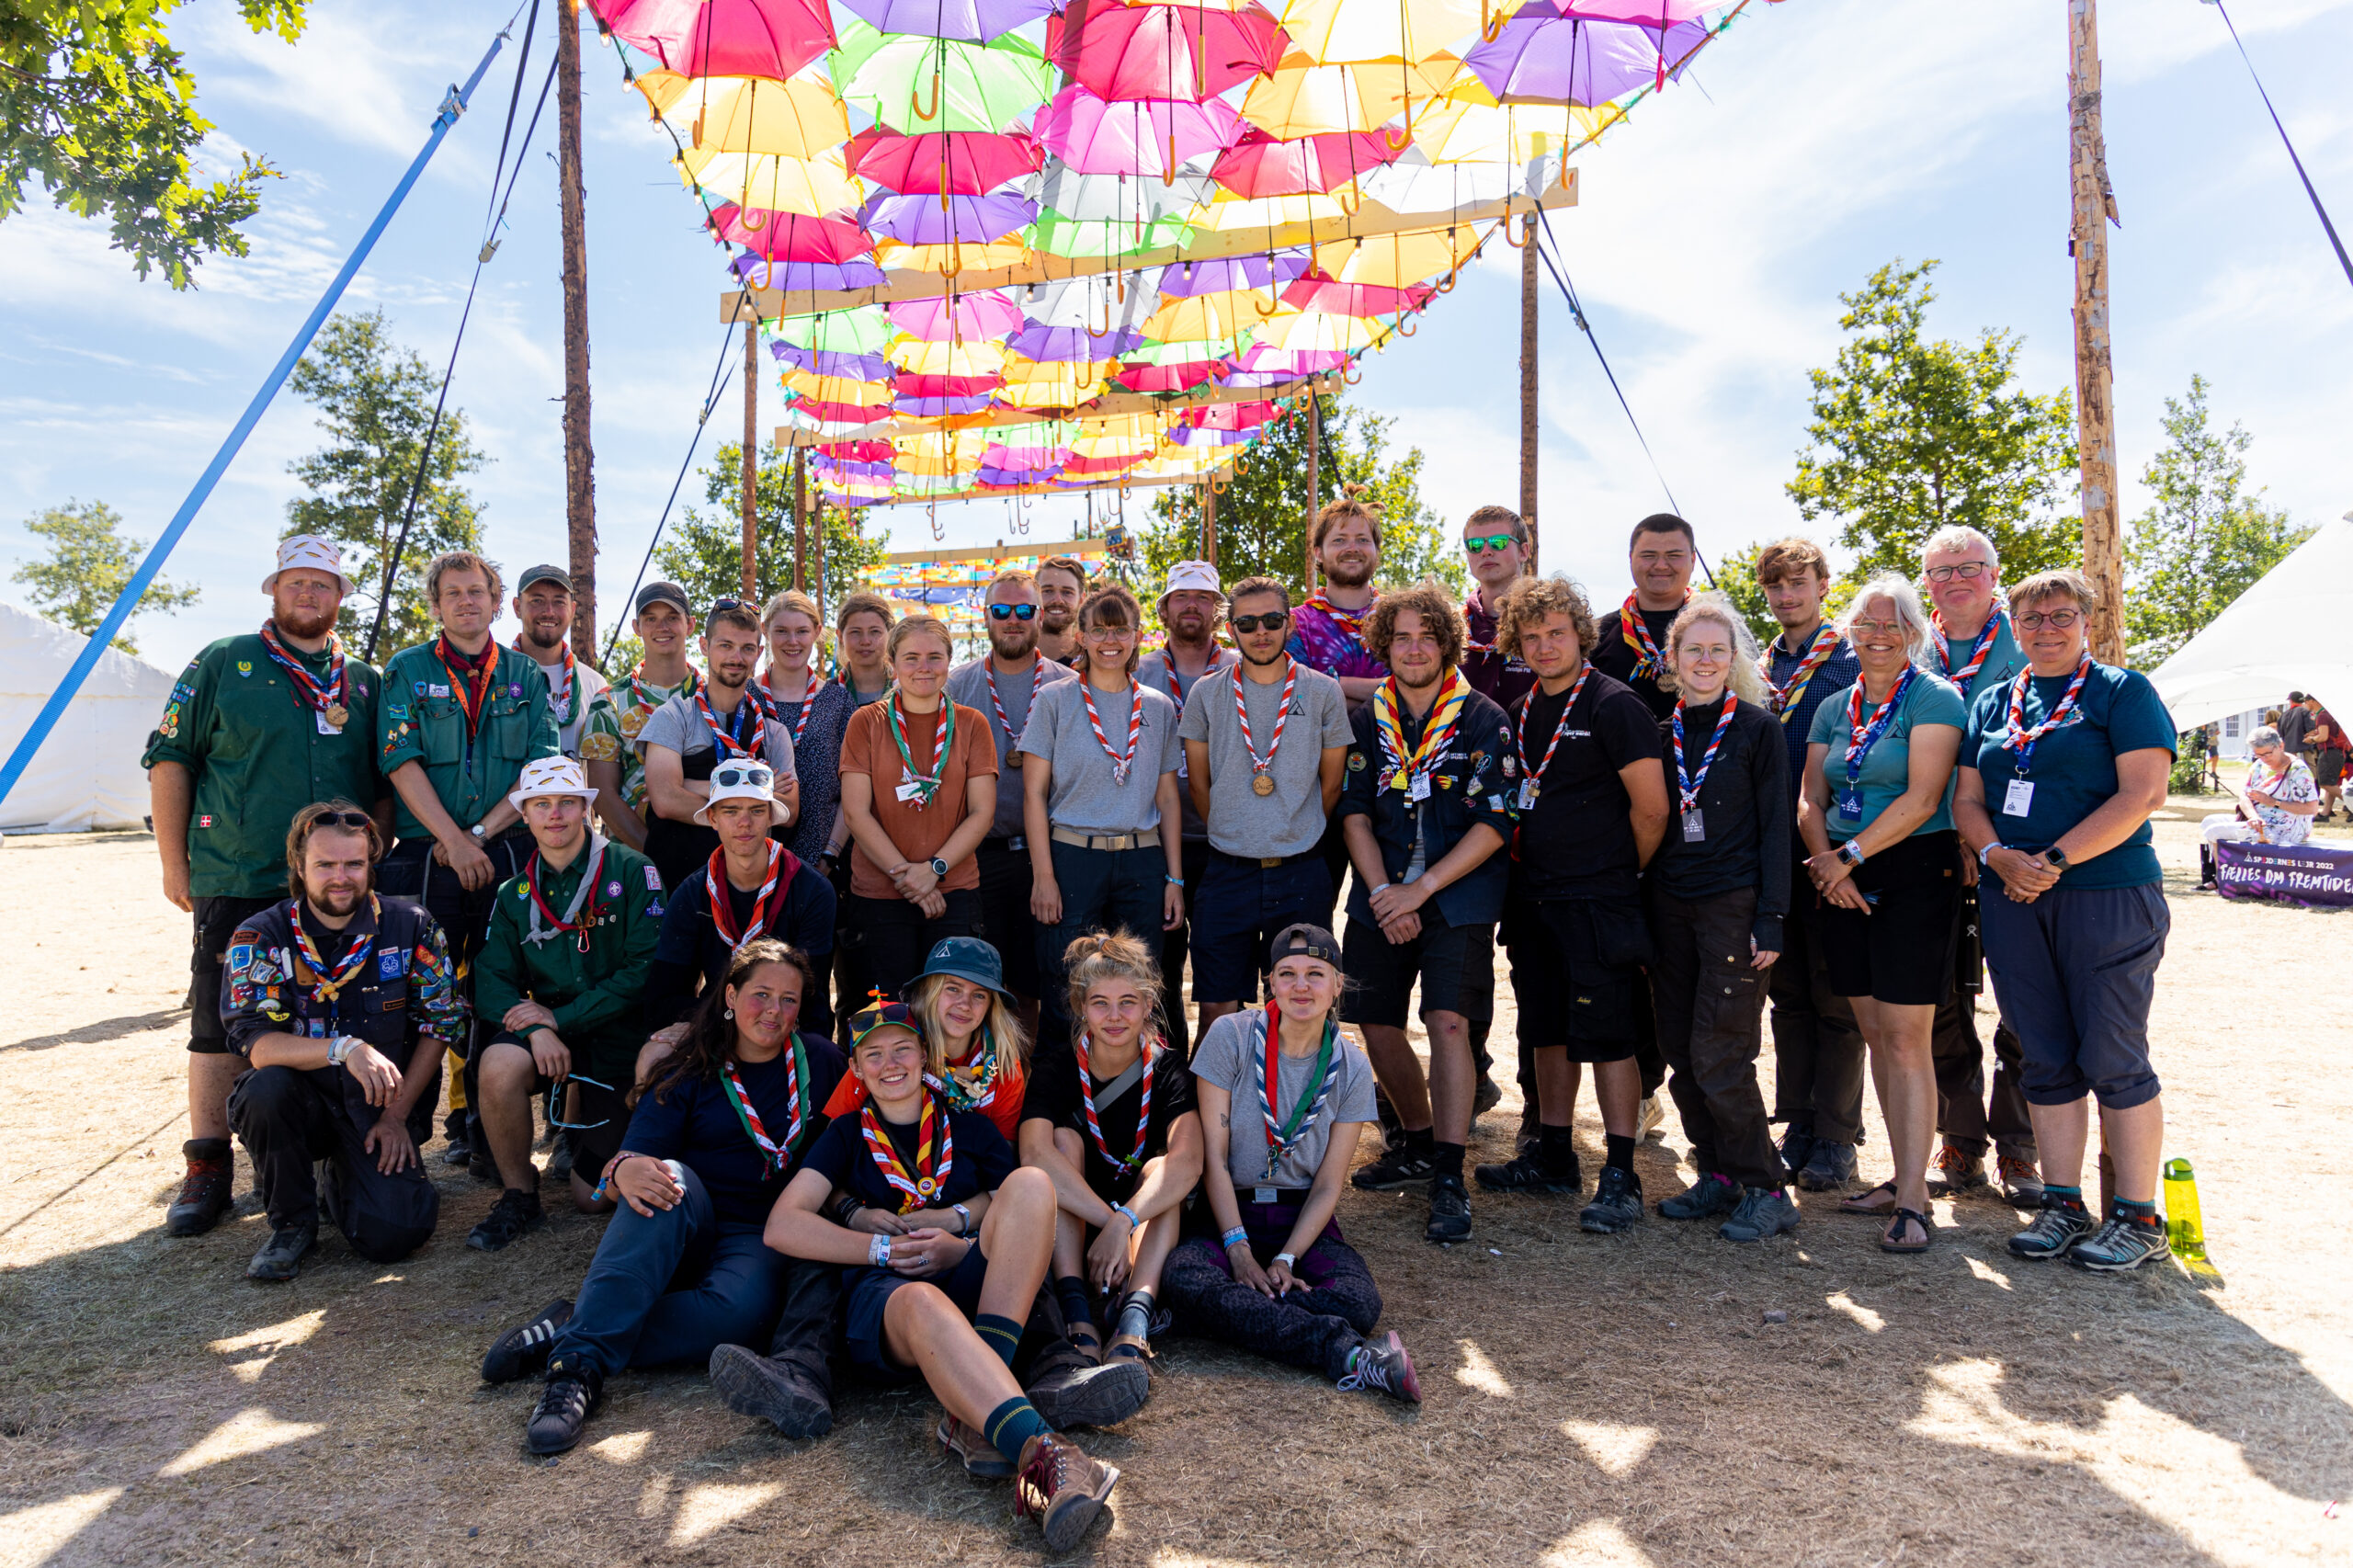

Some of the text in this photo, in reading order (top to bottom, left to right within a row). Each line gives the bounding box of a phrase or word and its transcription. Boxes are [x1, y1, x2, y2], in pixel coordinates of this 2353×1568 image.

[1413, 774, 1427, 783] VAGT
[2254, 856, 2295, 867] SPEJDERNES
[2298, 860, 2314, 869] LEJR
[2220, 864, 2261, 882] FÆLLES
